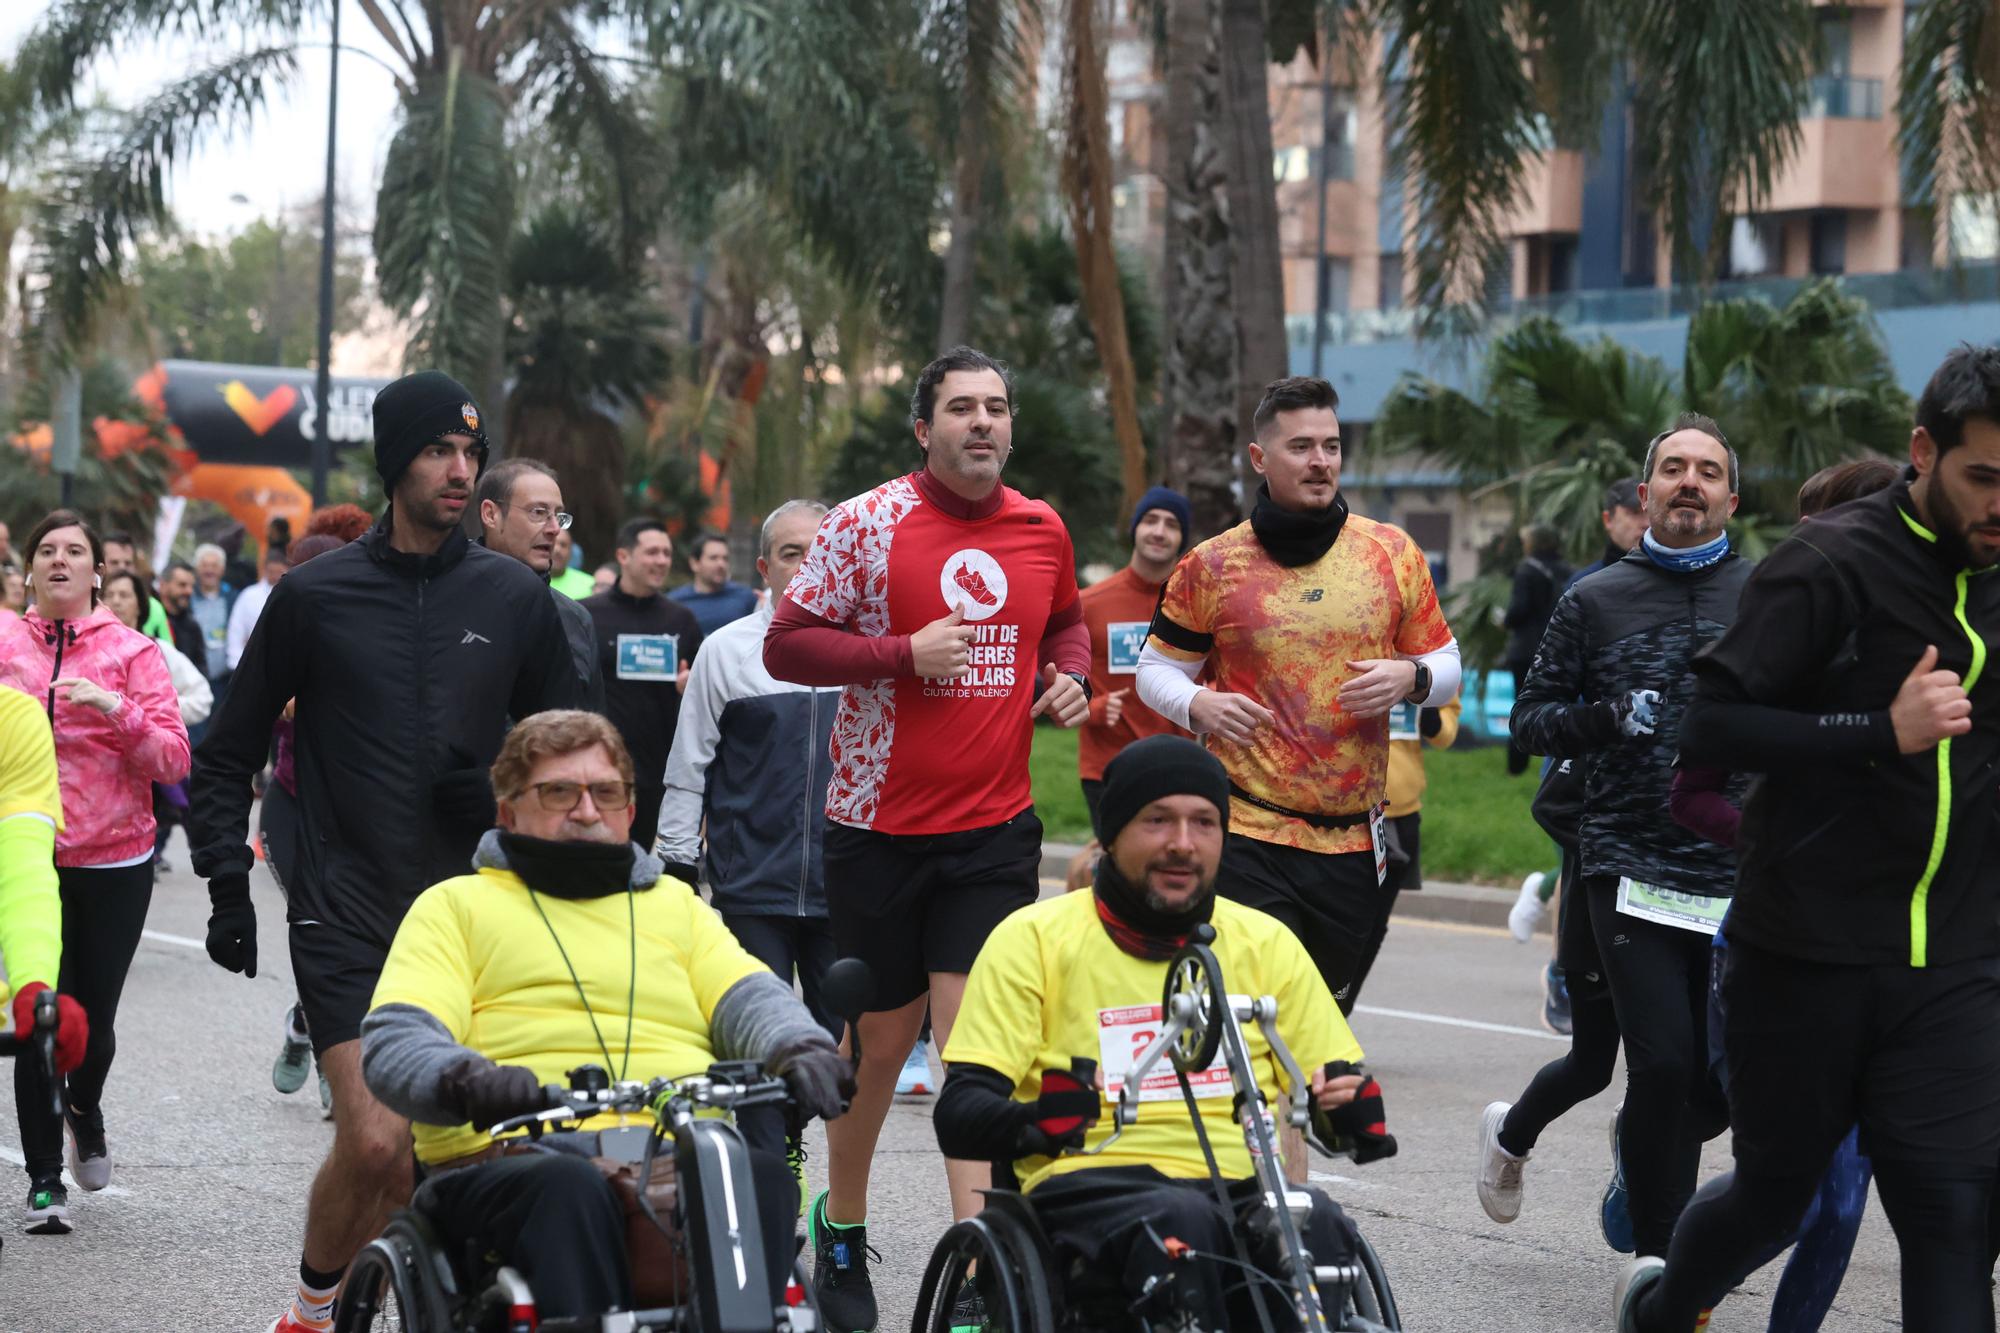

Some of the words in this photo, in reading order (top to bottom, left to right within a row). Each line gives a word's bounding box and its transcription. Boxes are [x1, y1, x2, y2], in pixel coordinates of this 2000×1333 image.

[1000, 624, 1019, 643] DE
[923, 687, 956, 698] CIUTAT
[957, 689, 970, 698] DE
[1818, 712, 1870, 727] KIPSTA
